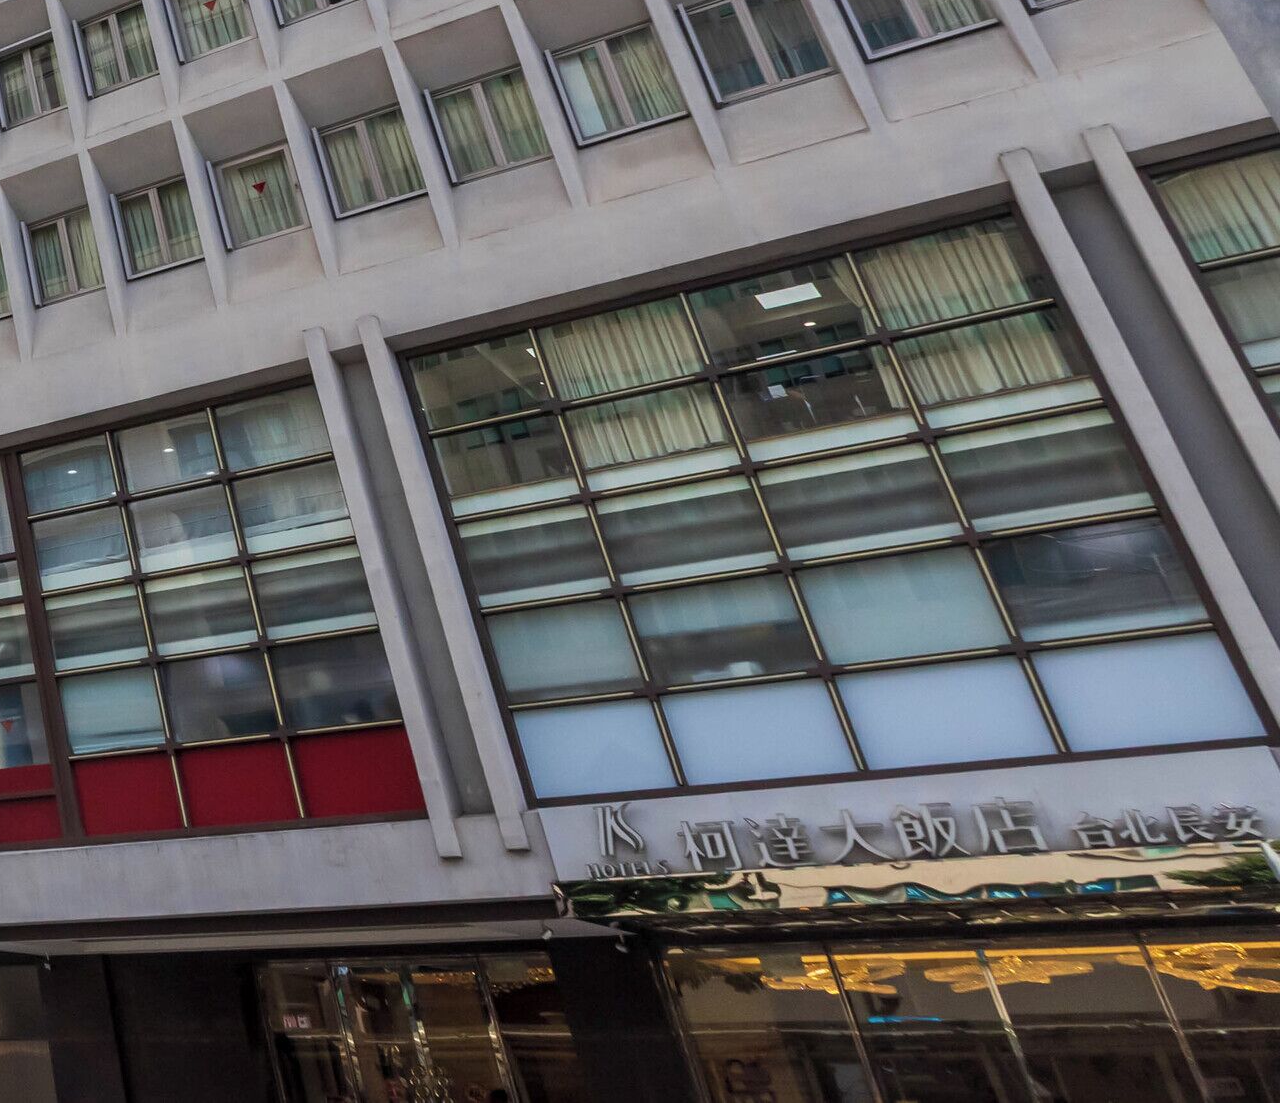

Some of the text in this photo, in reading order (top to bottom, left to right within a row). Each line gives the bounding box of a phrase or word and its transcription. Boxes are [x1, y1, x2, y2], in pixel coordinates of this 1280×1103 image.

[677, 796, 1049, 873] 柯達大飯店
[1072, 800, 1265, 848] 台北長安
[585, 859, 672, 879] HOTELS
